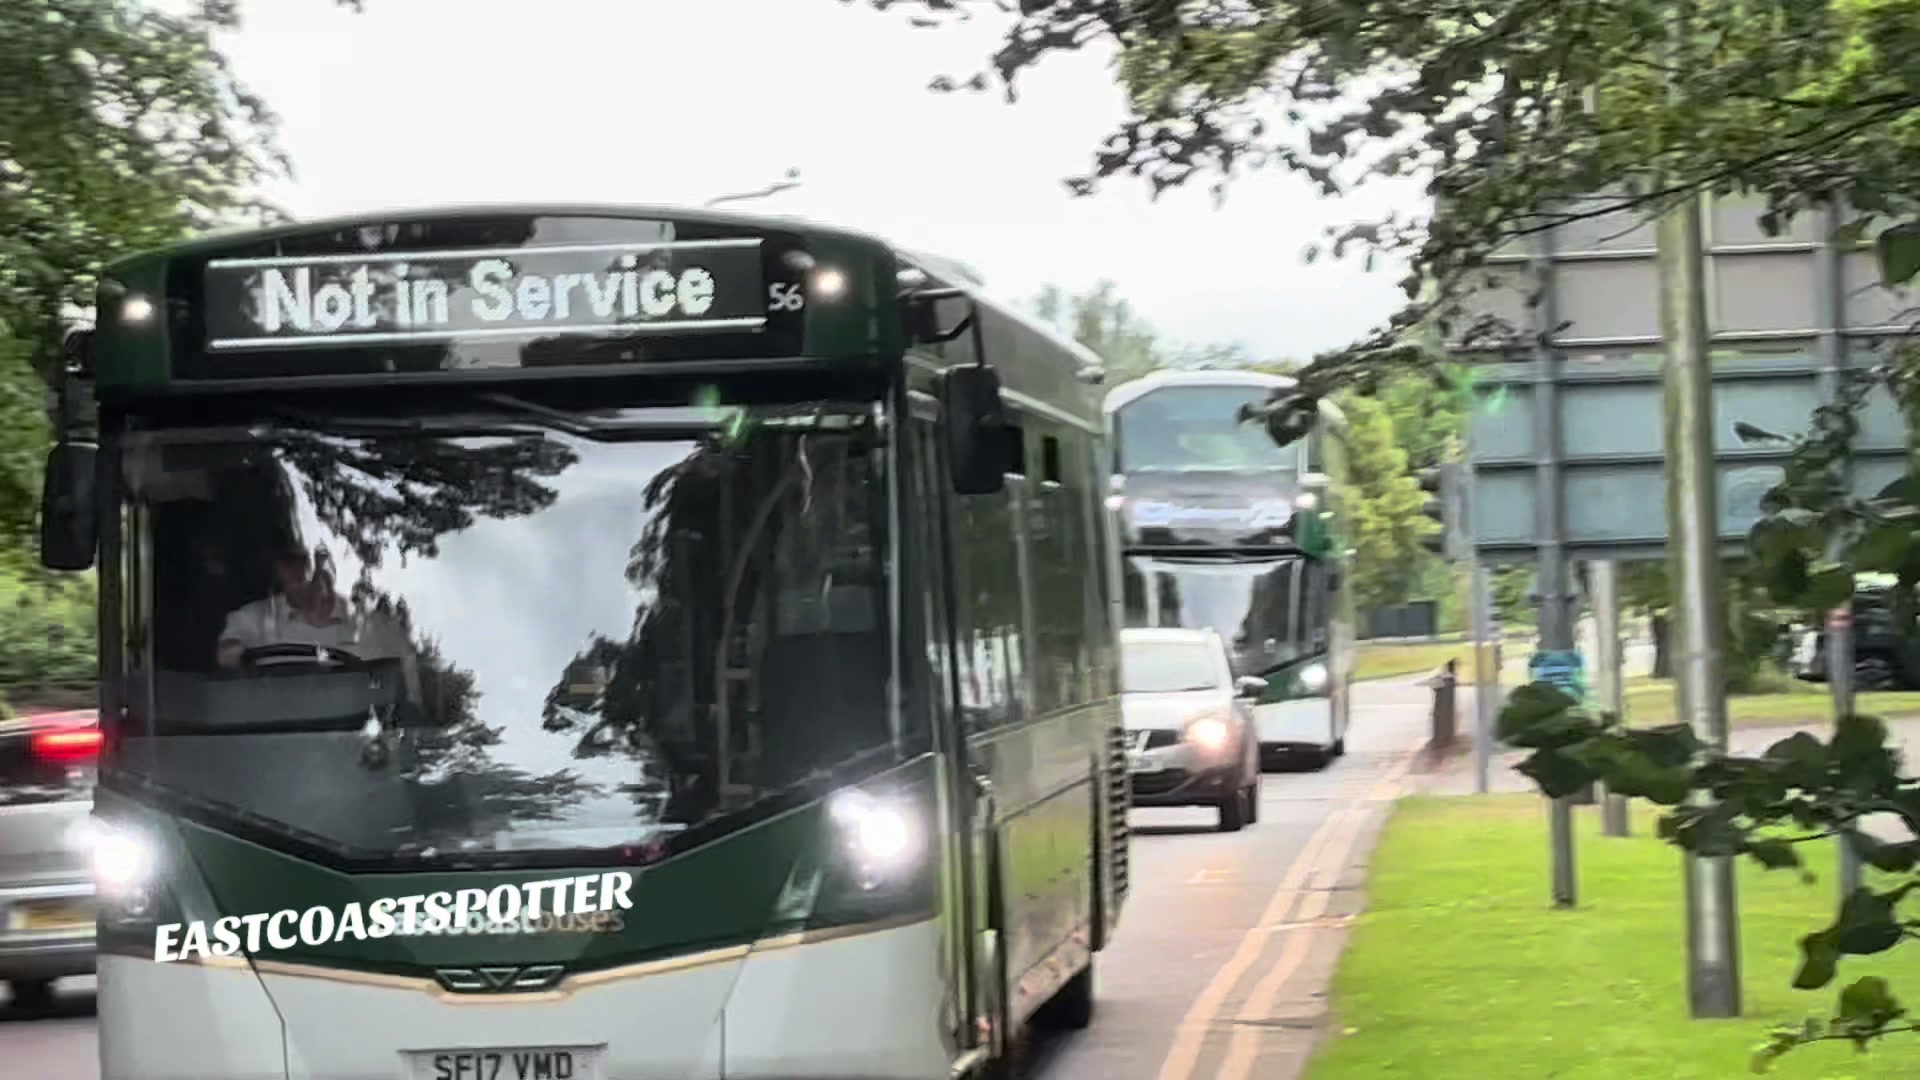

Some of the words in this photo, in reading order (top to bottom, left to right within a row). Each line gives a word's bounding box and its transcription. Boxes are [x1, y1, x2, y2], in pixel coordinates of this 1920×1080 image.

[261, 266, 374, 332] Not
[399, 264, 448, 325] in
[471, 255, 714, 320] Service
[768, 282, 804, 312] 56
[434, 1053, 502, 1080] SF17
[513, 1052, 573, 1079] VMD
